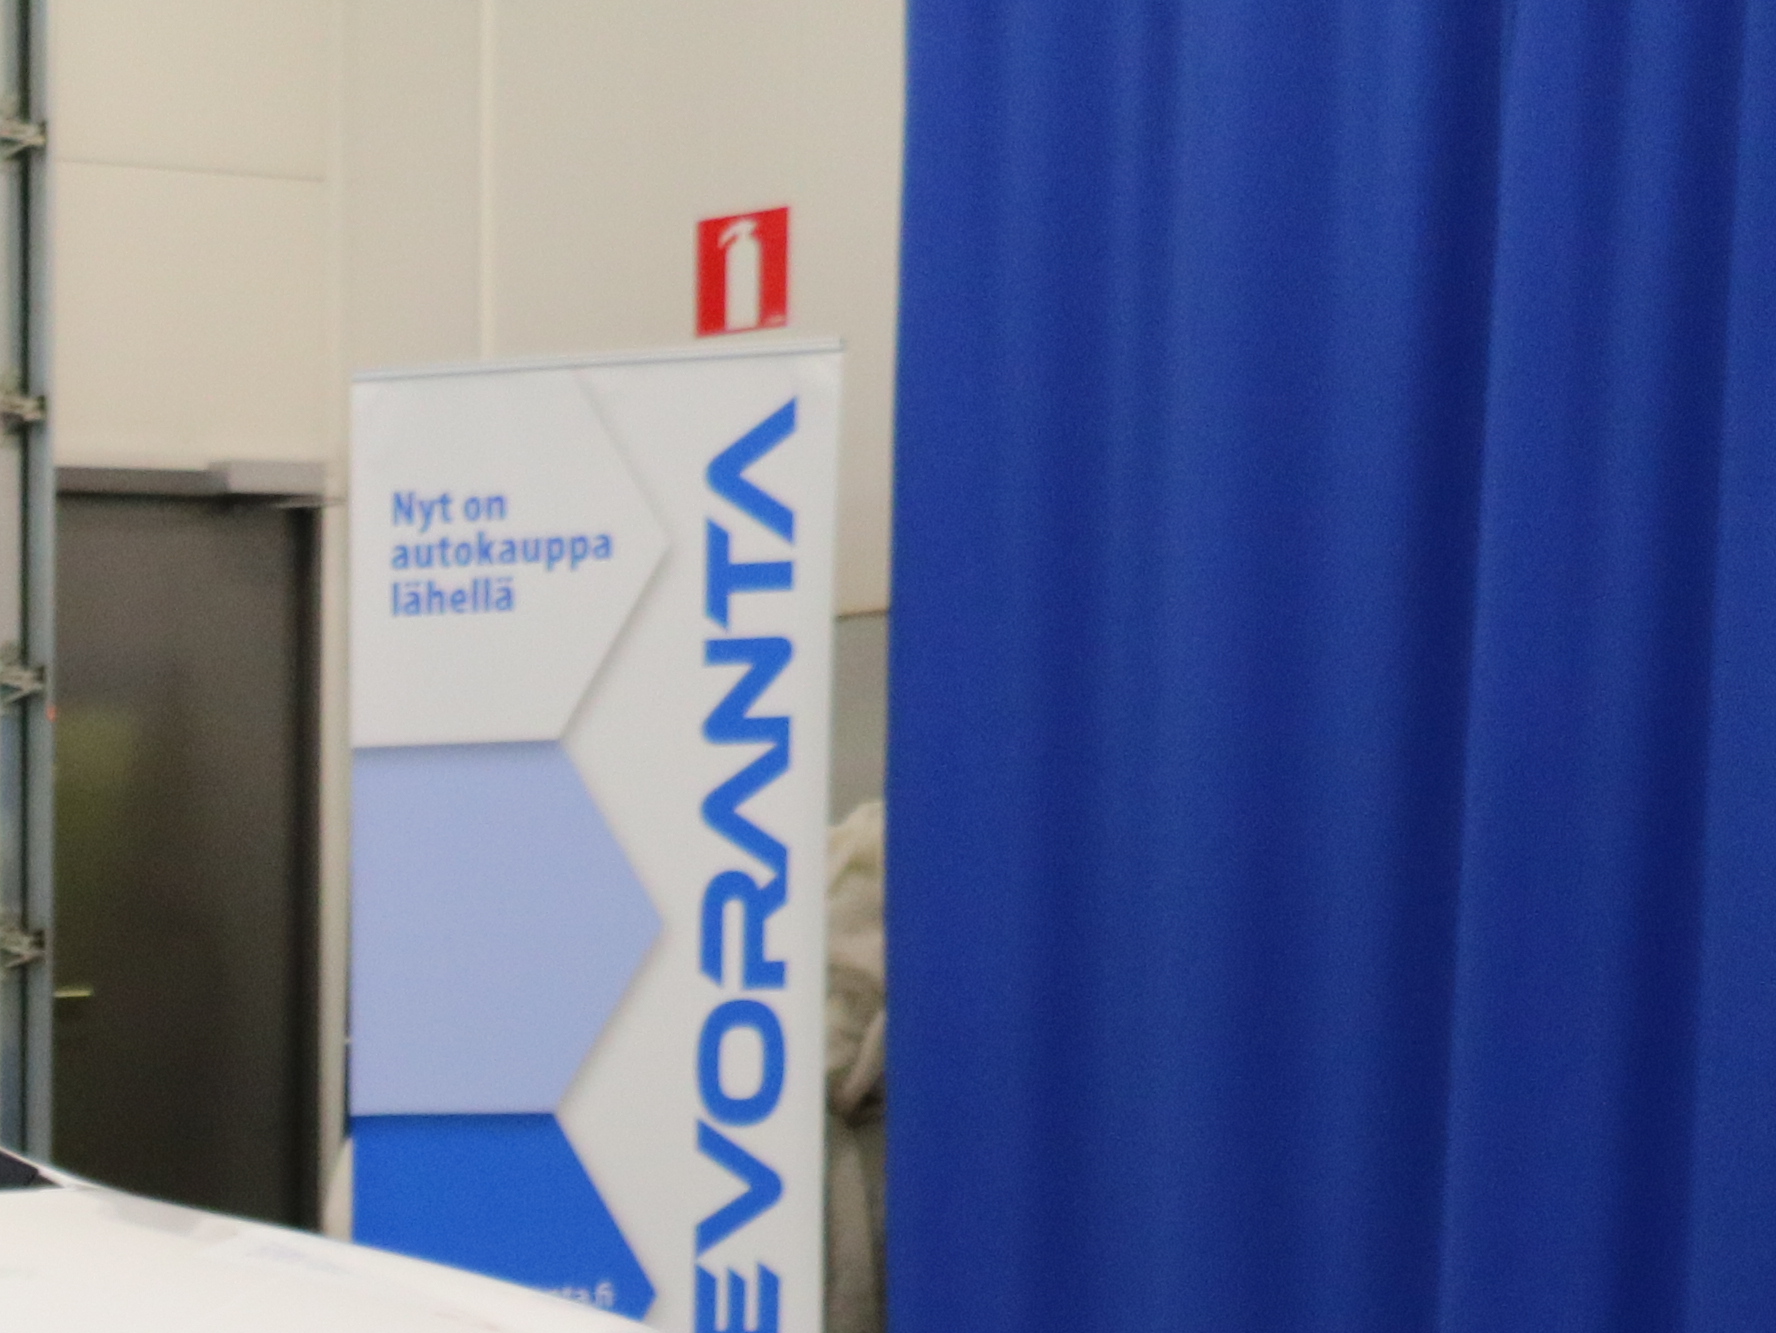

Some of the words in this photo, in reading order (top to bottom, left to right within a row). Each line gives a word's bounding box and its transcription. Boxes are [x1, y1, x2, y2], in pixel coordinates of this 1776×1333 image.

[391, 492, 452, 532] Nyt
[464, 494, 507, 520] on
[391, 533, 614, 571] autokauppa
[391, 577, 516, 616] lähellä
